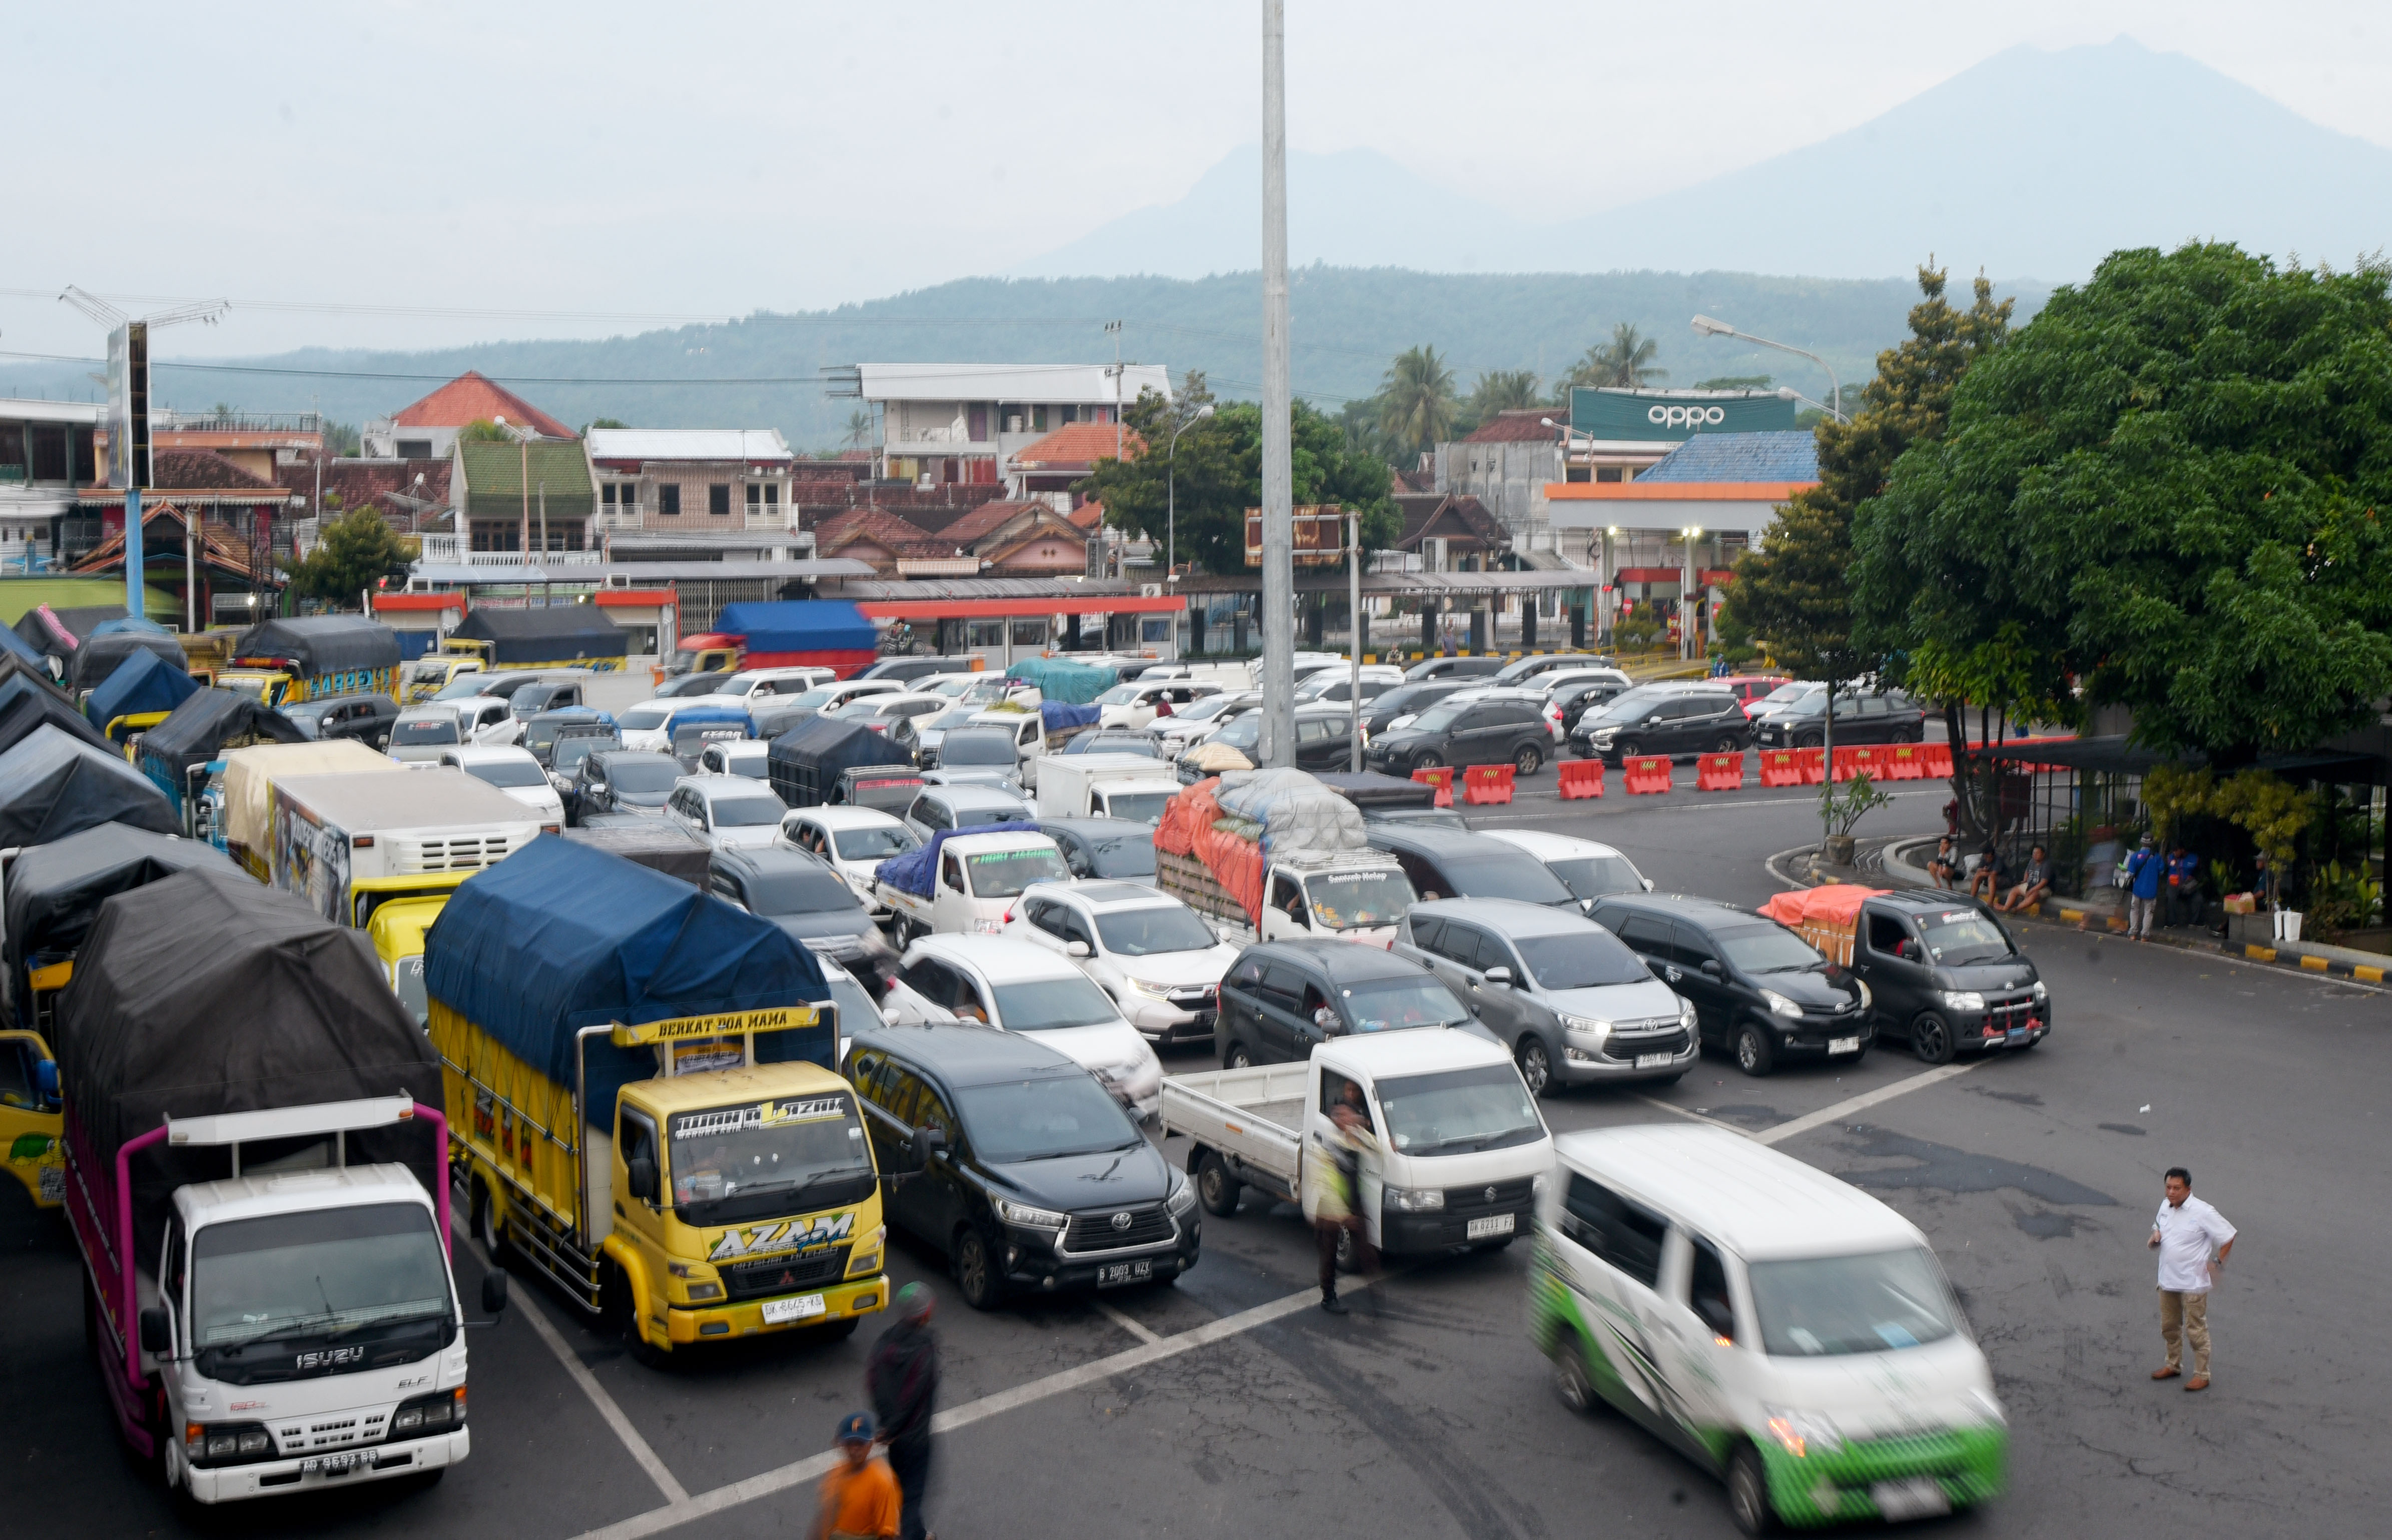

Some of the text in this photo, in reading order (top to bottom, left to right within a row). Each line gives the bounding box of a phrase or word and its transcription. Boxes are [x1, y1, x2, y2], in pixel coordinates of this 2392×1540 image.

[1648, 405, 1724, 429] oppo
[659, 1017, 713, 1037] BERKAT
[748, 1010, 787, 1028] MAMA
[709, 1212, 855, 1262] AZAM
[1099, 1268, 1105, 1281] B
[297, 1346, 364, 1369] ISUZU
[398, 1375, 428, 1389] ELF
